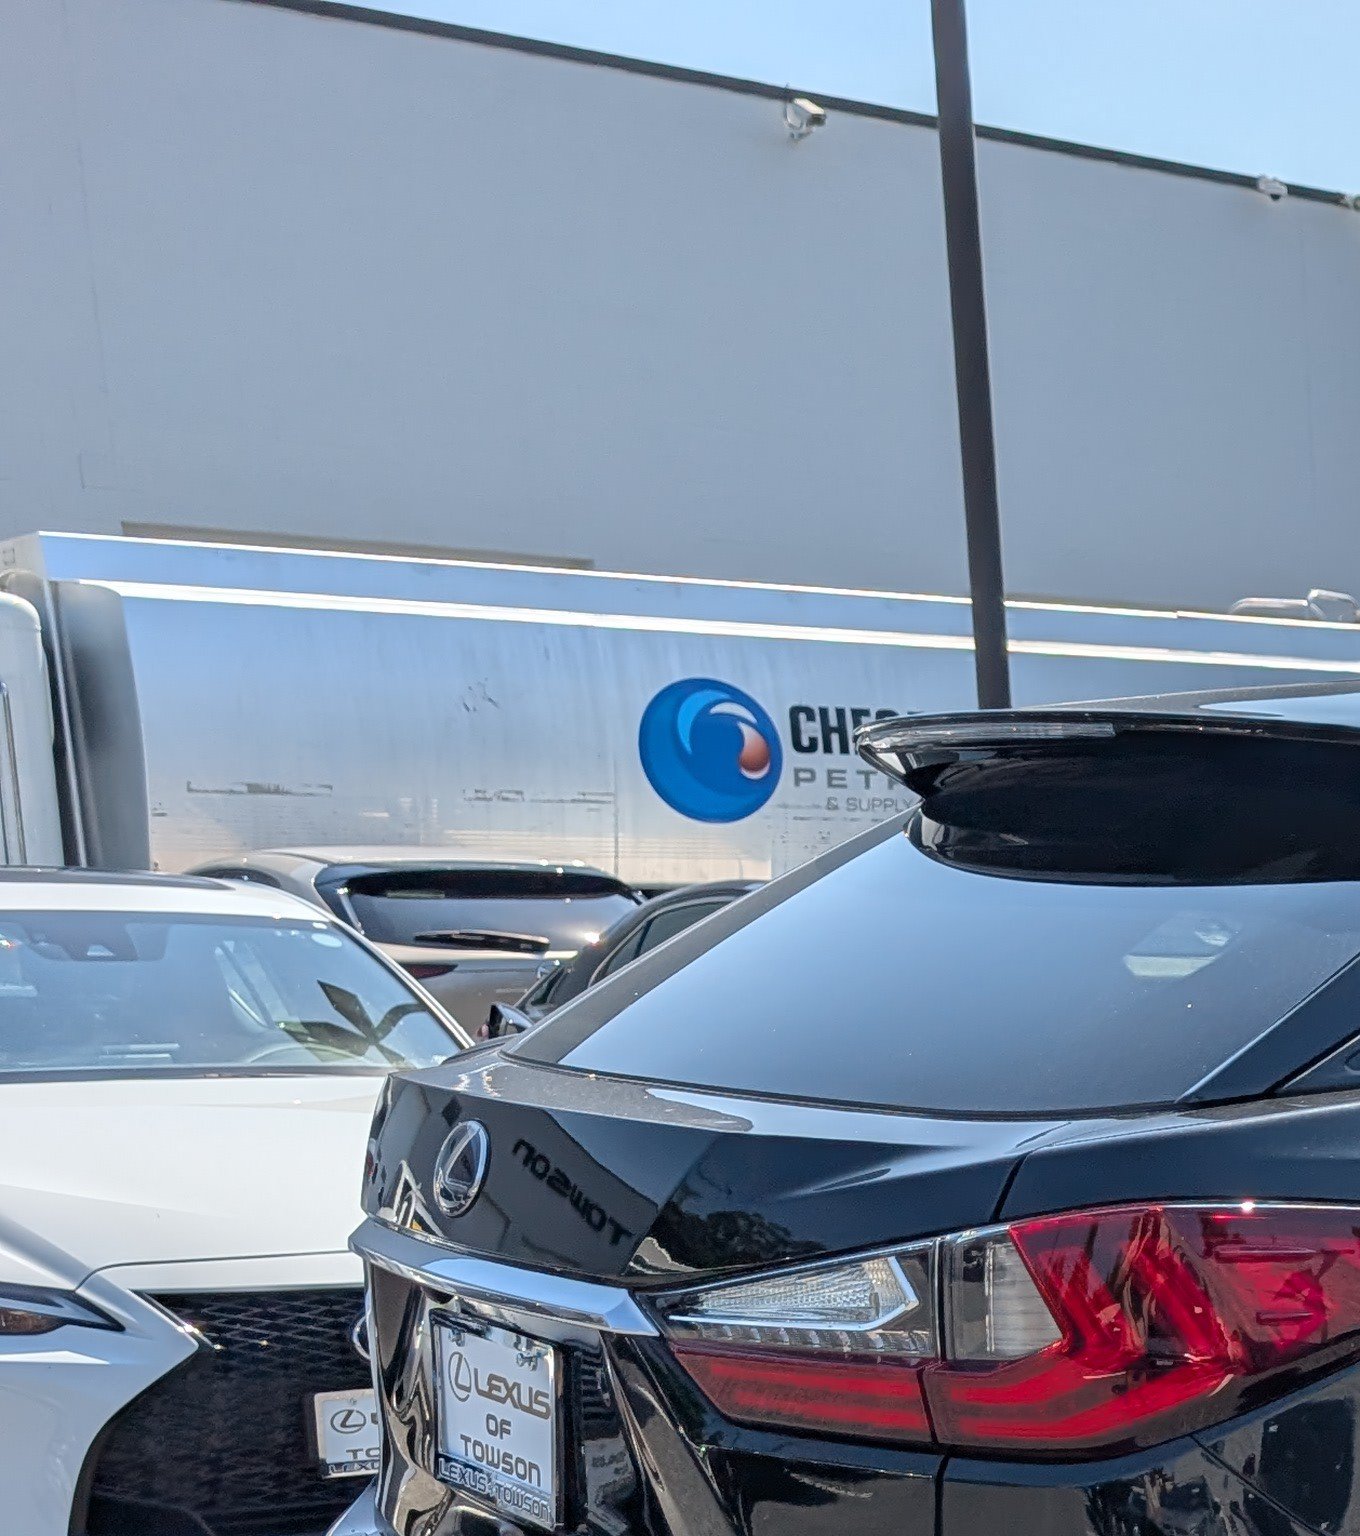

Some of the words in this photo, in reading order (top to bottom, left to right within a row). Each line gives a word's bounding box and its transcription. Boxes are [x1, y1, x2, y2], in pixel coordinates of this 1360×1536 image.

[846, 797, 912, 812] SUPPLY
[474, 1367, 550, 1420] LEXUS
[486, 1413, 512, 1440] OF
[460, 1434, 541, 1487] TOWSON
[439, 1457, 488, 1494] LEXUS
[494, 1478, 551, 1523] TOWSON
